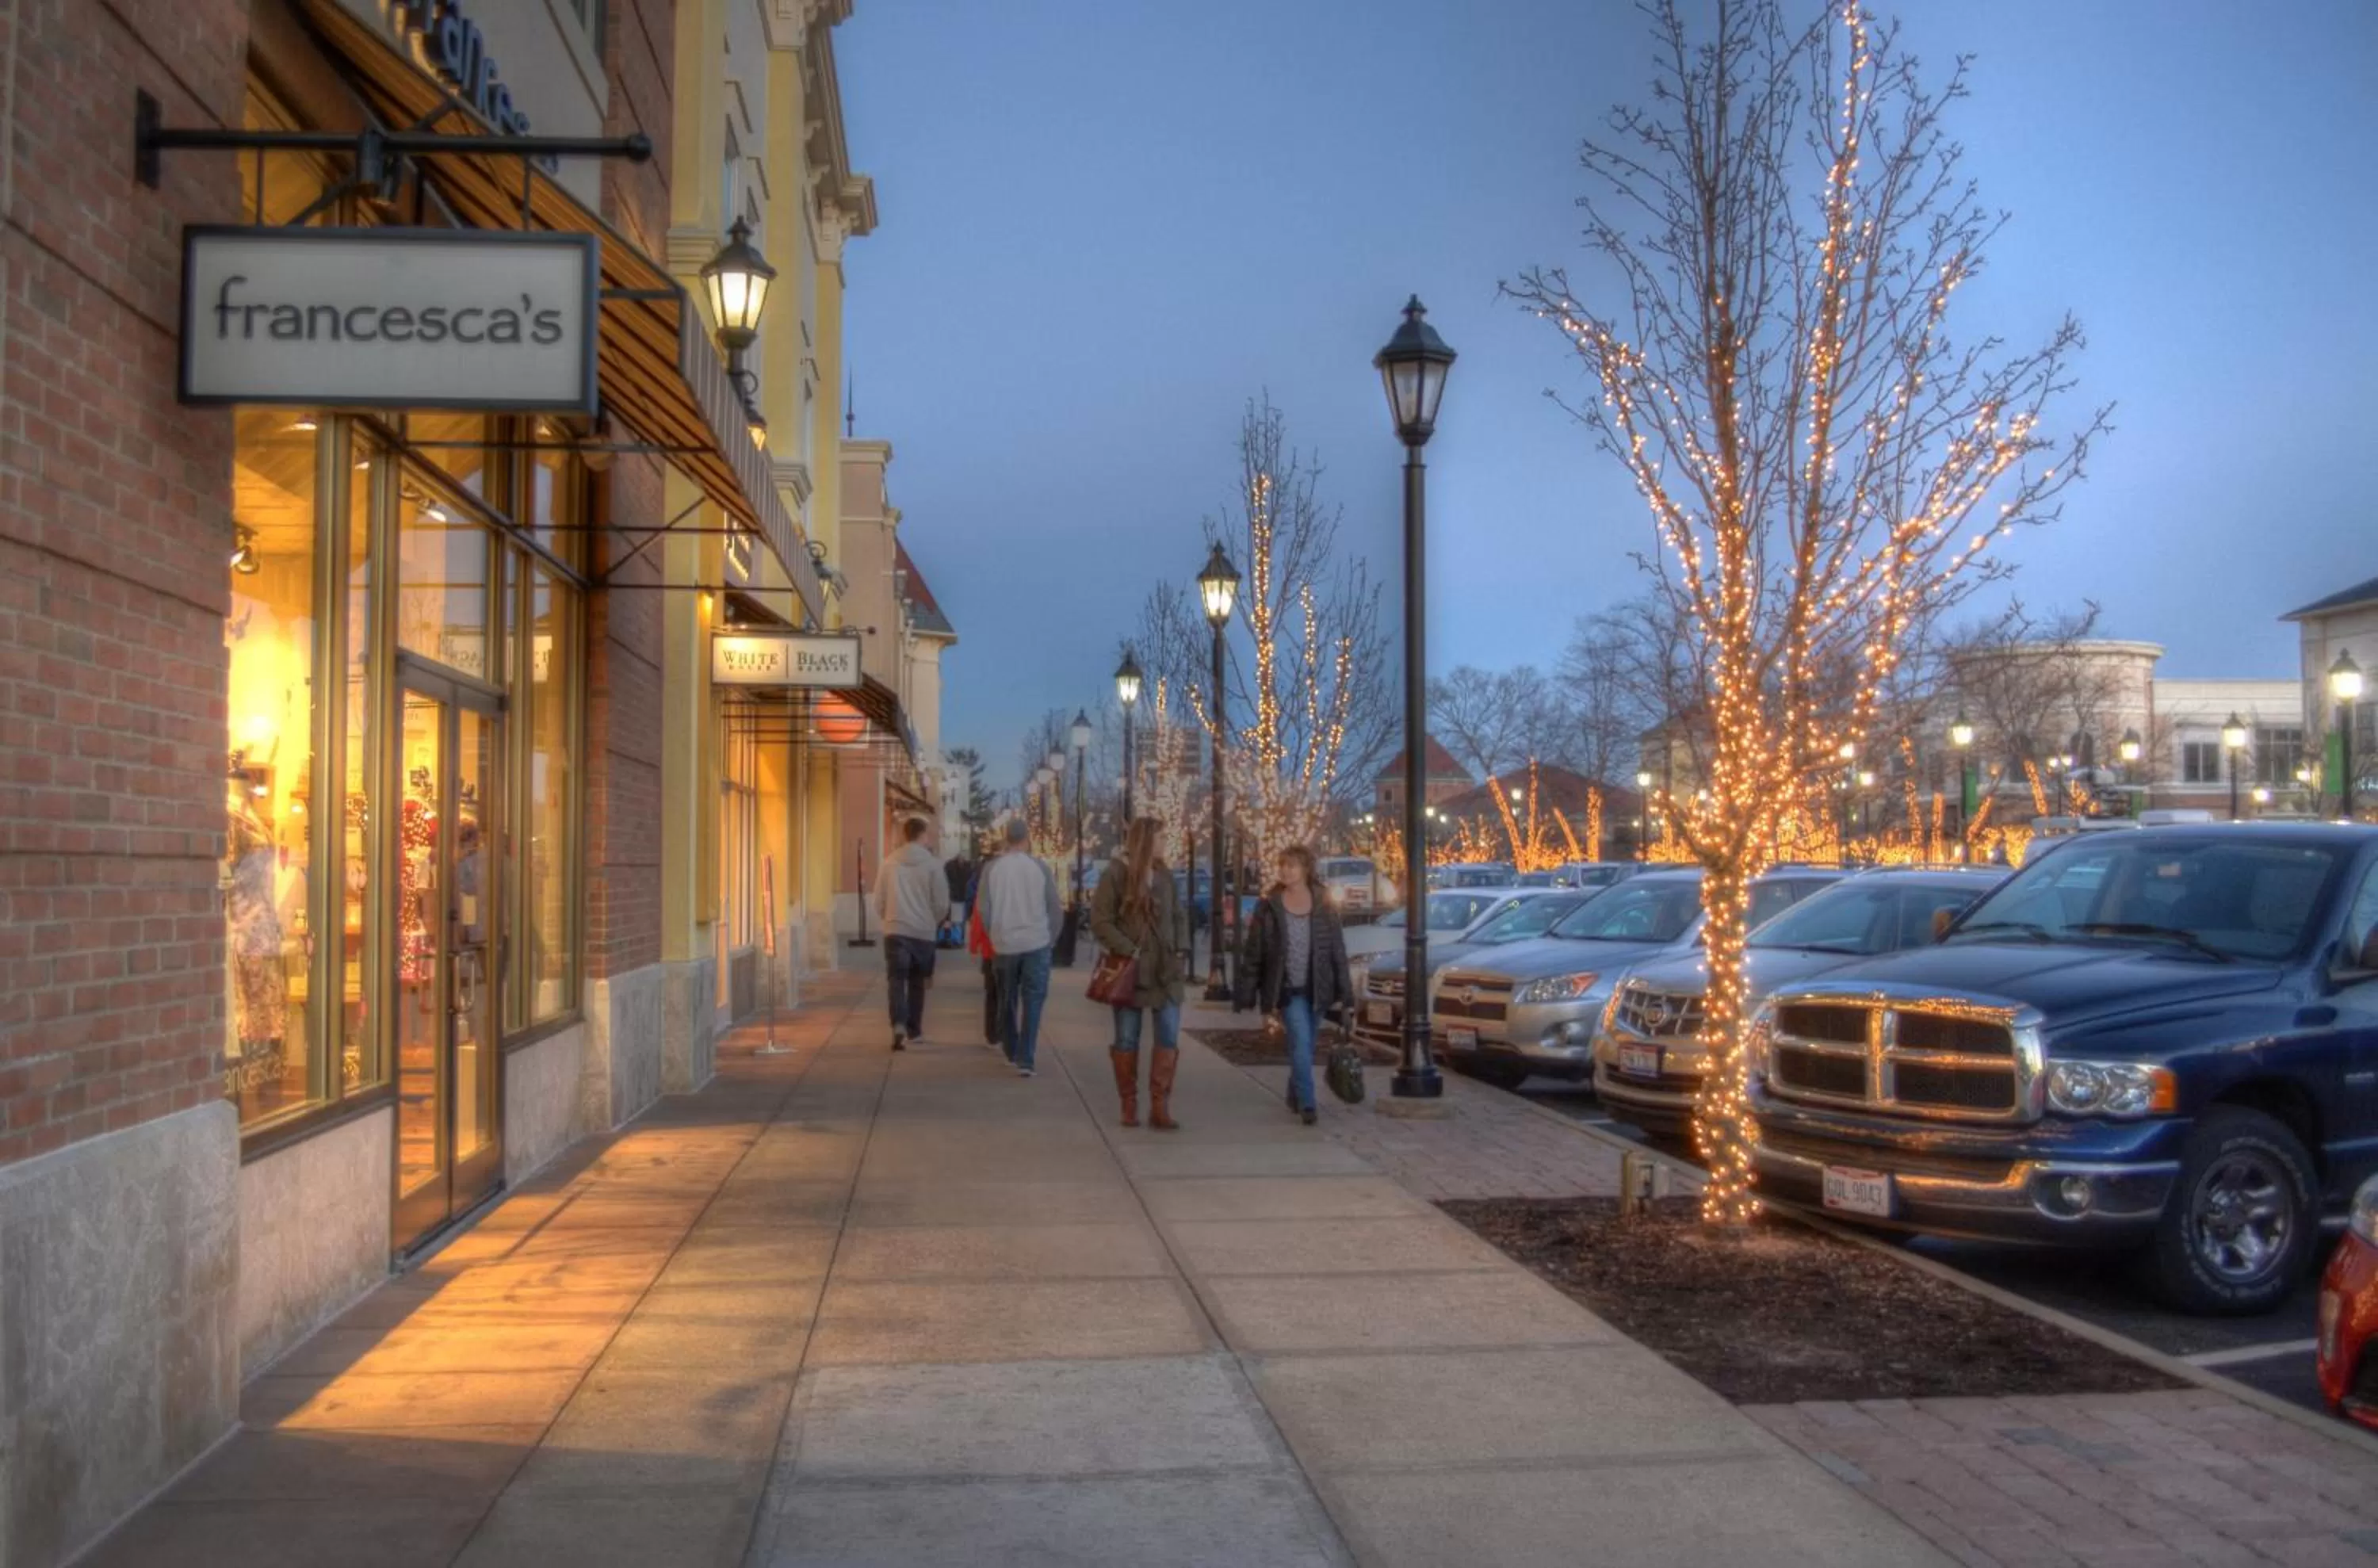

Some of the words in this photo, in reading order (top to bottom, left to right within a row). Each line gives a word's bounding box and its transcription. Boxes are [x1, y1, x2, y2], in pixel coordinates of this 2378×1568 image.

[213, 275, 564, 346] francesca's
[723, 649, 778, 665] WHITE
[797, 650, 848, 666] BLACK
